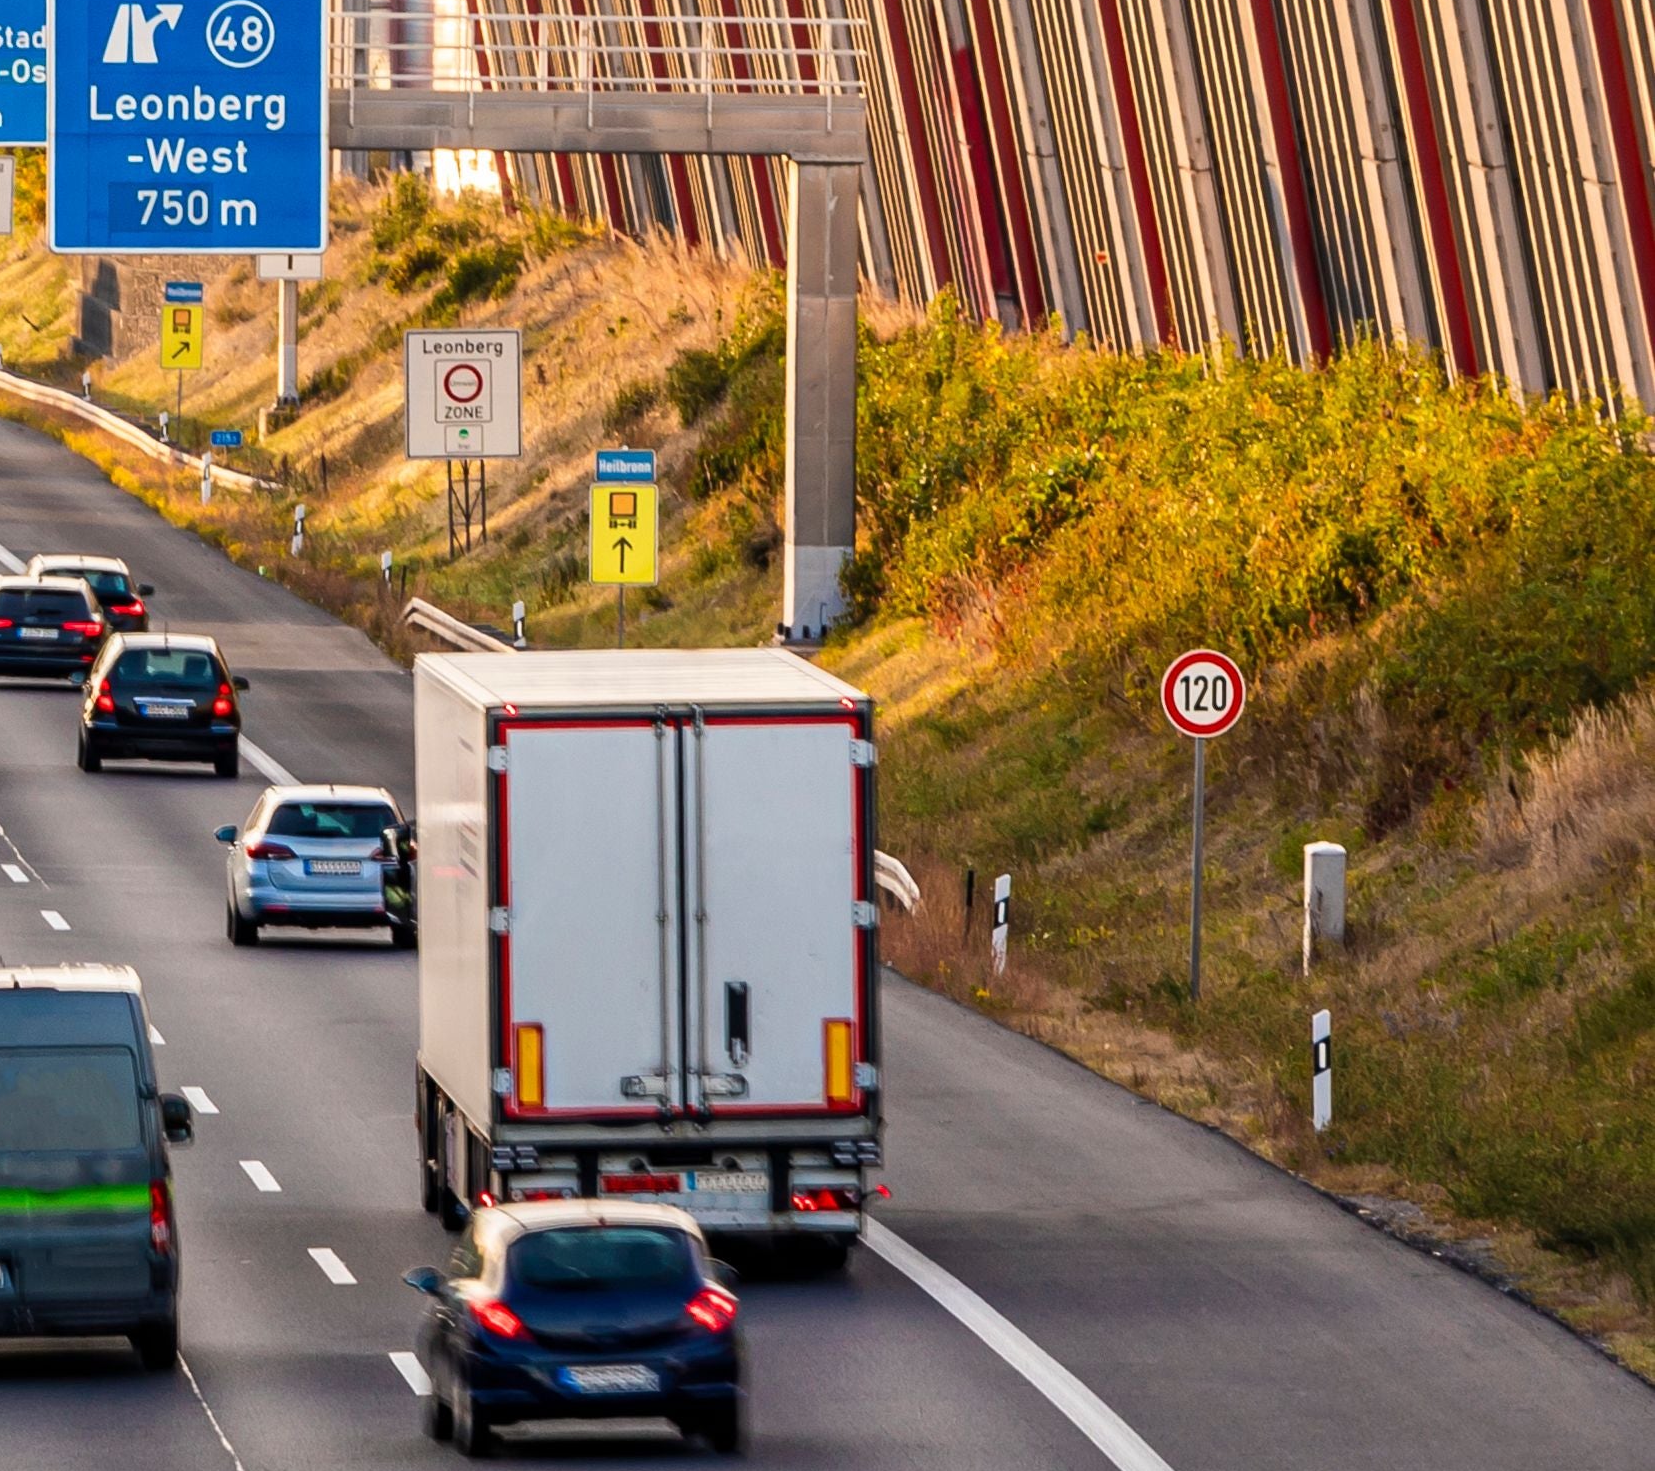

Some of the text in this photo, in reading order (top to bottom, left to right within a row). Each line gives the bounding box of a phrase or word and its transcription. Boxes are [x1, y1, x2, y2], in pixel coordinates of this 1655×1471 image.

[214, 16, 264, 53] 48
[89, 86, 287, 131] Leonberg
[127, 138, 248, 174] -West
[137, 190, 257, 226] 750 m
[423, 339, 503, 358] Leonberg
[445, 406, 484, 420] ZONE
[599, 459, 652, 474] Heilbronn
[1180, 675, 1228, 713] 120
